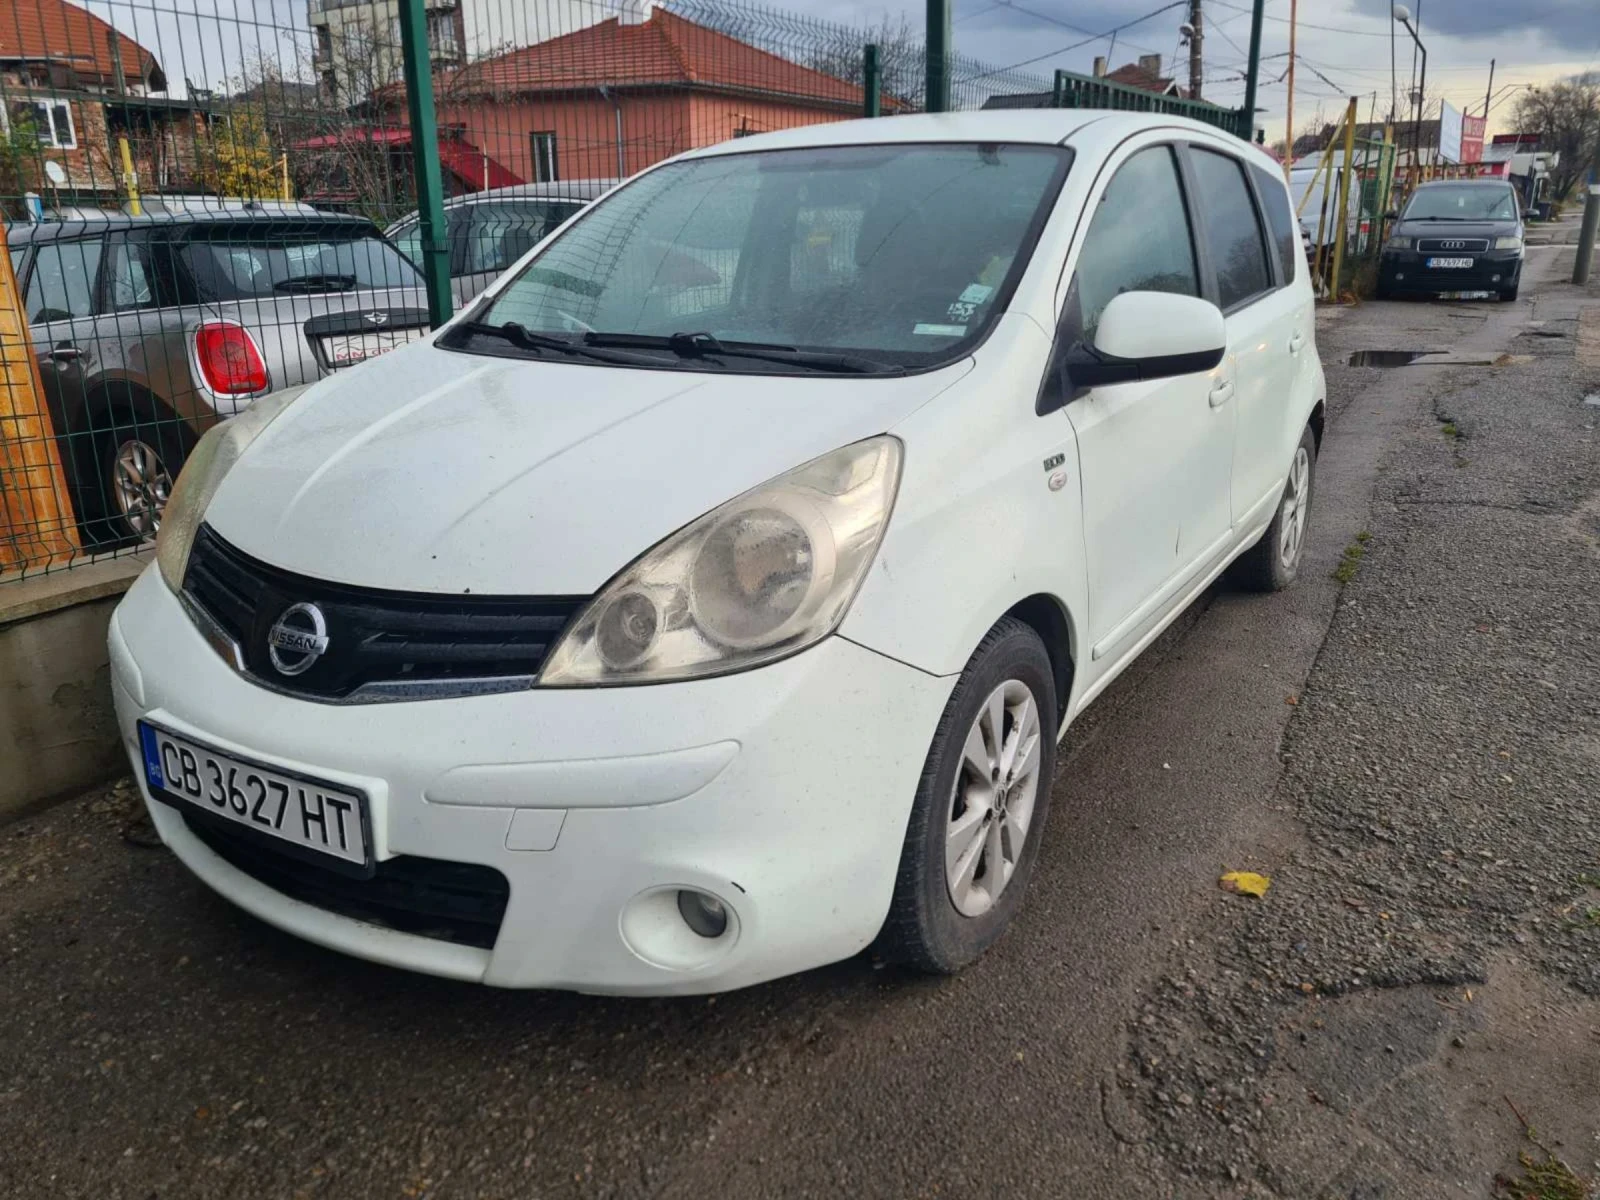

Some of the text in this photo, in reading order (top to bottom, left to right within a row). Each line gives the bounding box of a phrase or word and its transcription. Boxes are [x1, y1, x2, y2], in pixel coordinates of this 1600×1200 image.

[271, 627, 317, 650] NISSAN
[161, 741, 352, 851] CB 3627 HT
